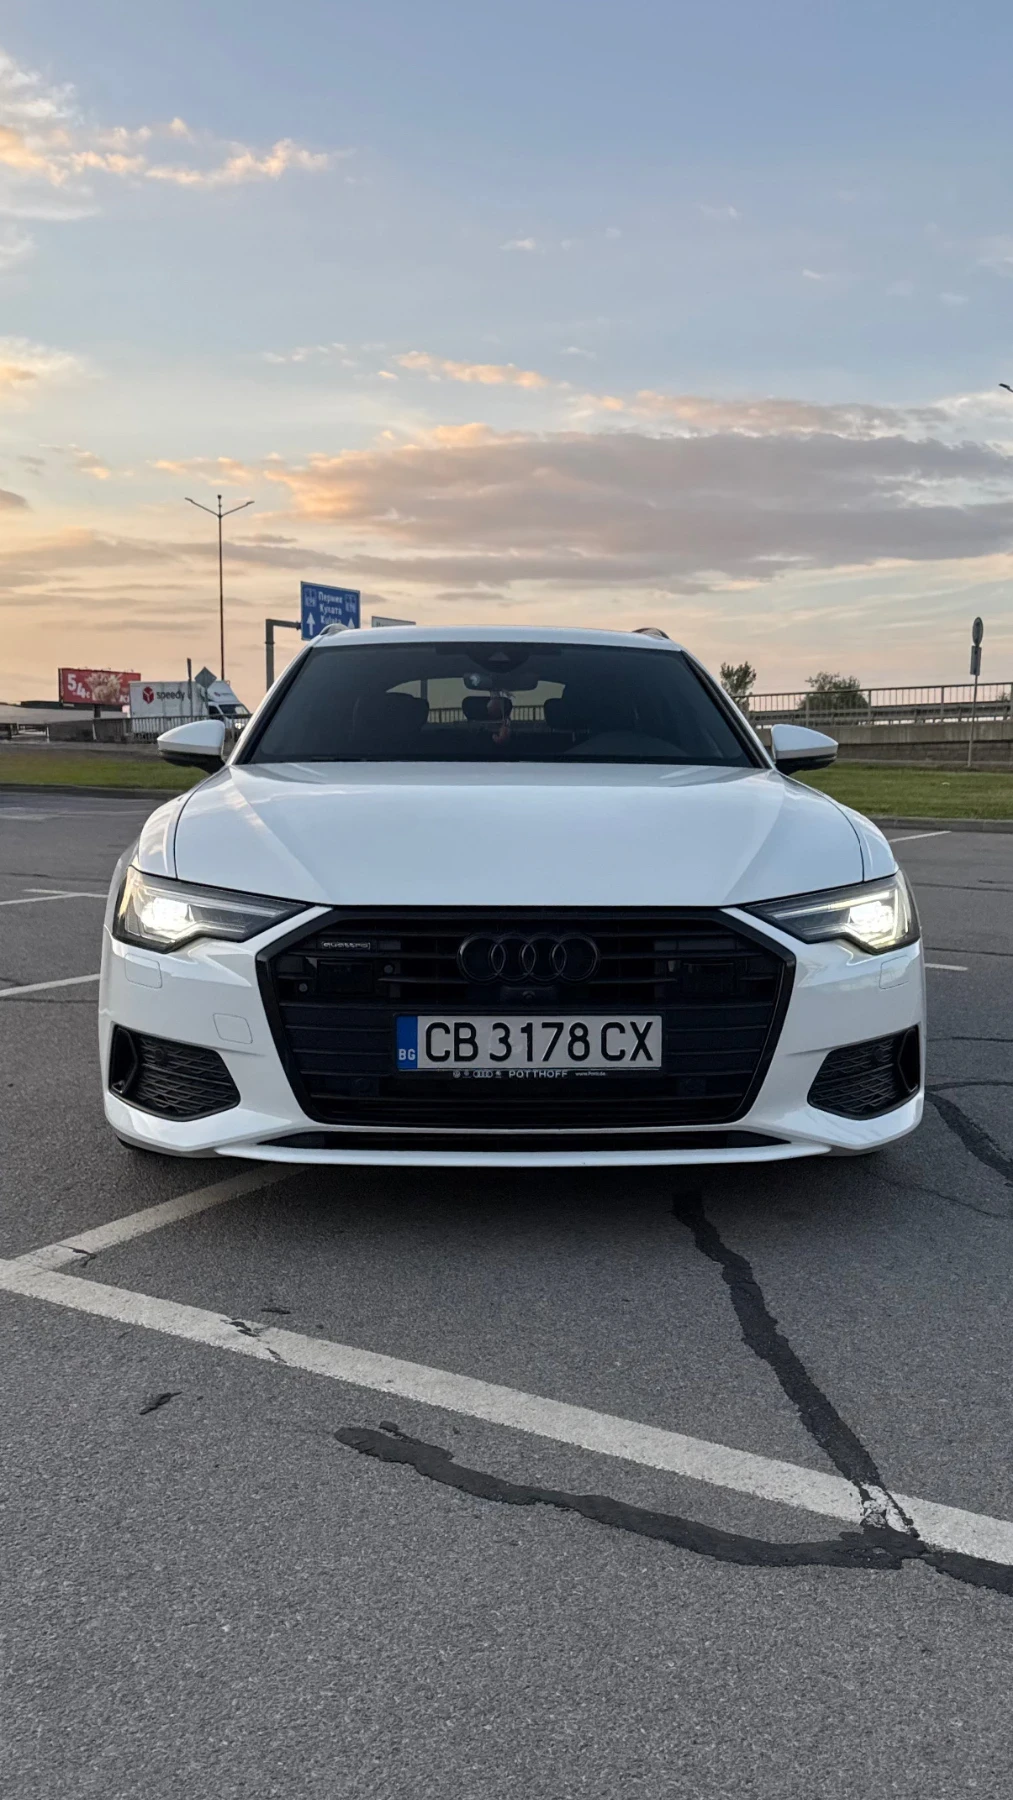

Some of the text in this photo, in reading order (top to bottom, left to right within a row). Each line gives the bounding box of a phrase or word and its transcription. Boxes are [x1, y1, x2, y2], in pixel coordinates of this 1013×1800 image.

[156, 689, 186, 701] speedy
[425, 1021, 654, 1062] CB 3178 CX
[398, 1049, 416, 1061] BG
[508, 1070, 568, 1079] POTTHOFF
